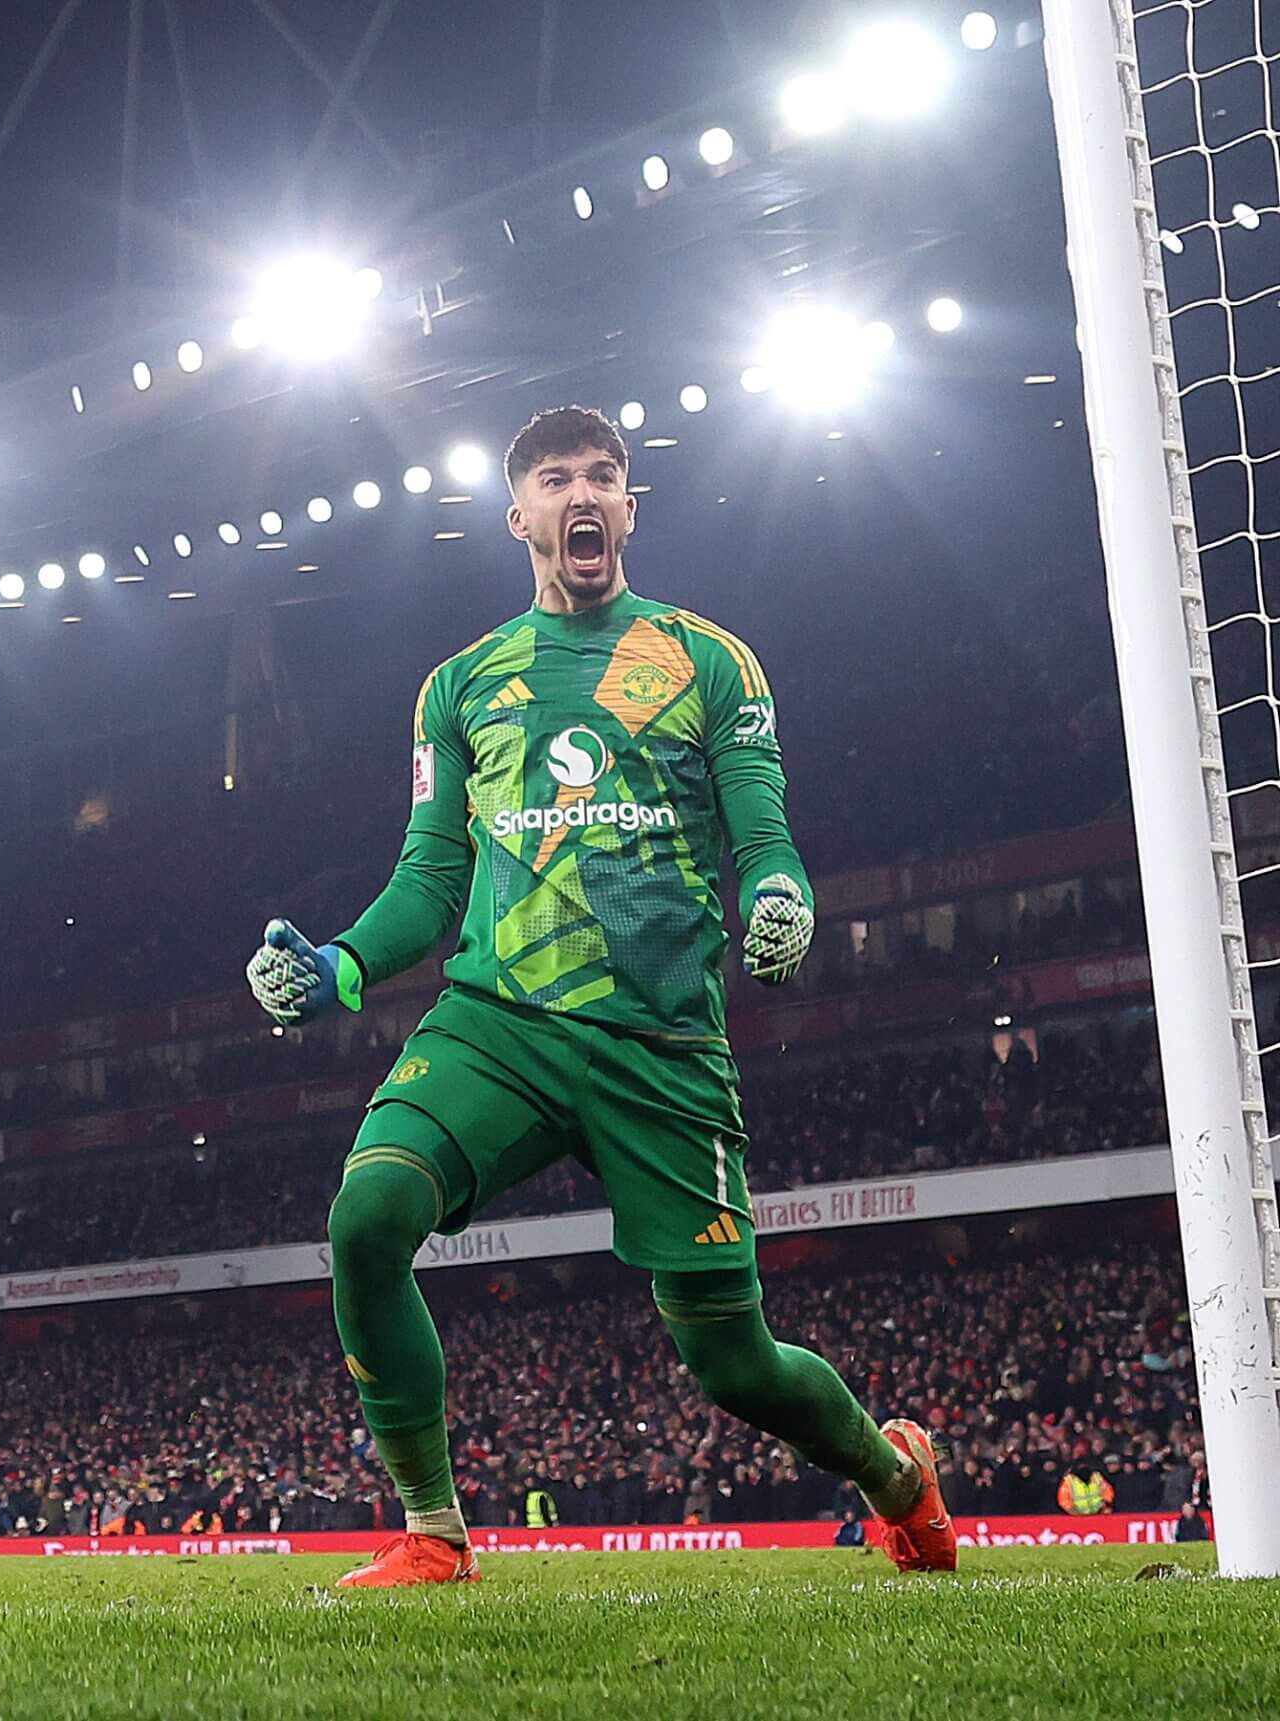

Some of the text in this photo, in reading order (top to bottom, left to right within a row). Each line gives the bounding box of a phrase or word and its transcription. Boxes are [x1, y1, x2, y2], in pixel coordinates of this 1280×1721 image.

[492, 798, 676, 838] Snapdragon
[753, 1185, 916, 1230] irates FLY BETTER
[427, 1230, 510, 1263] SOBHA
